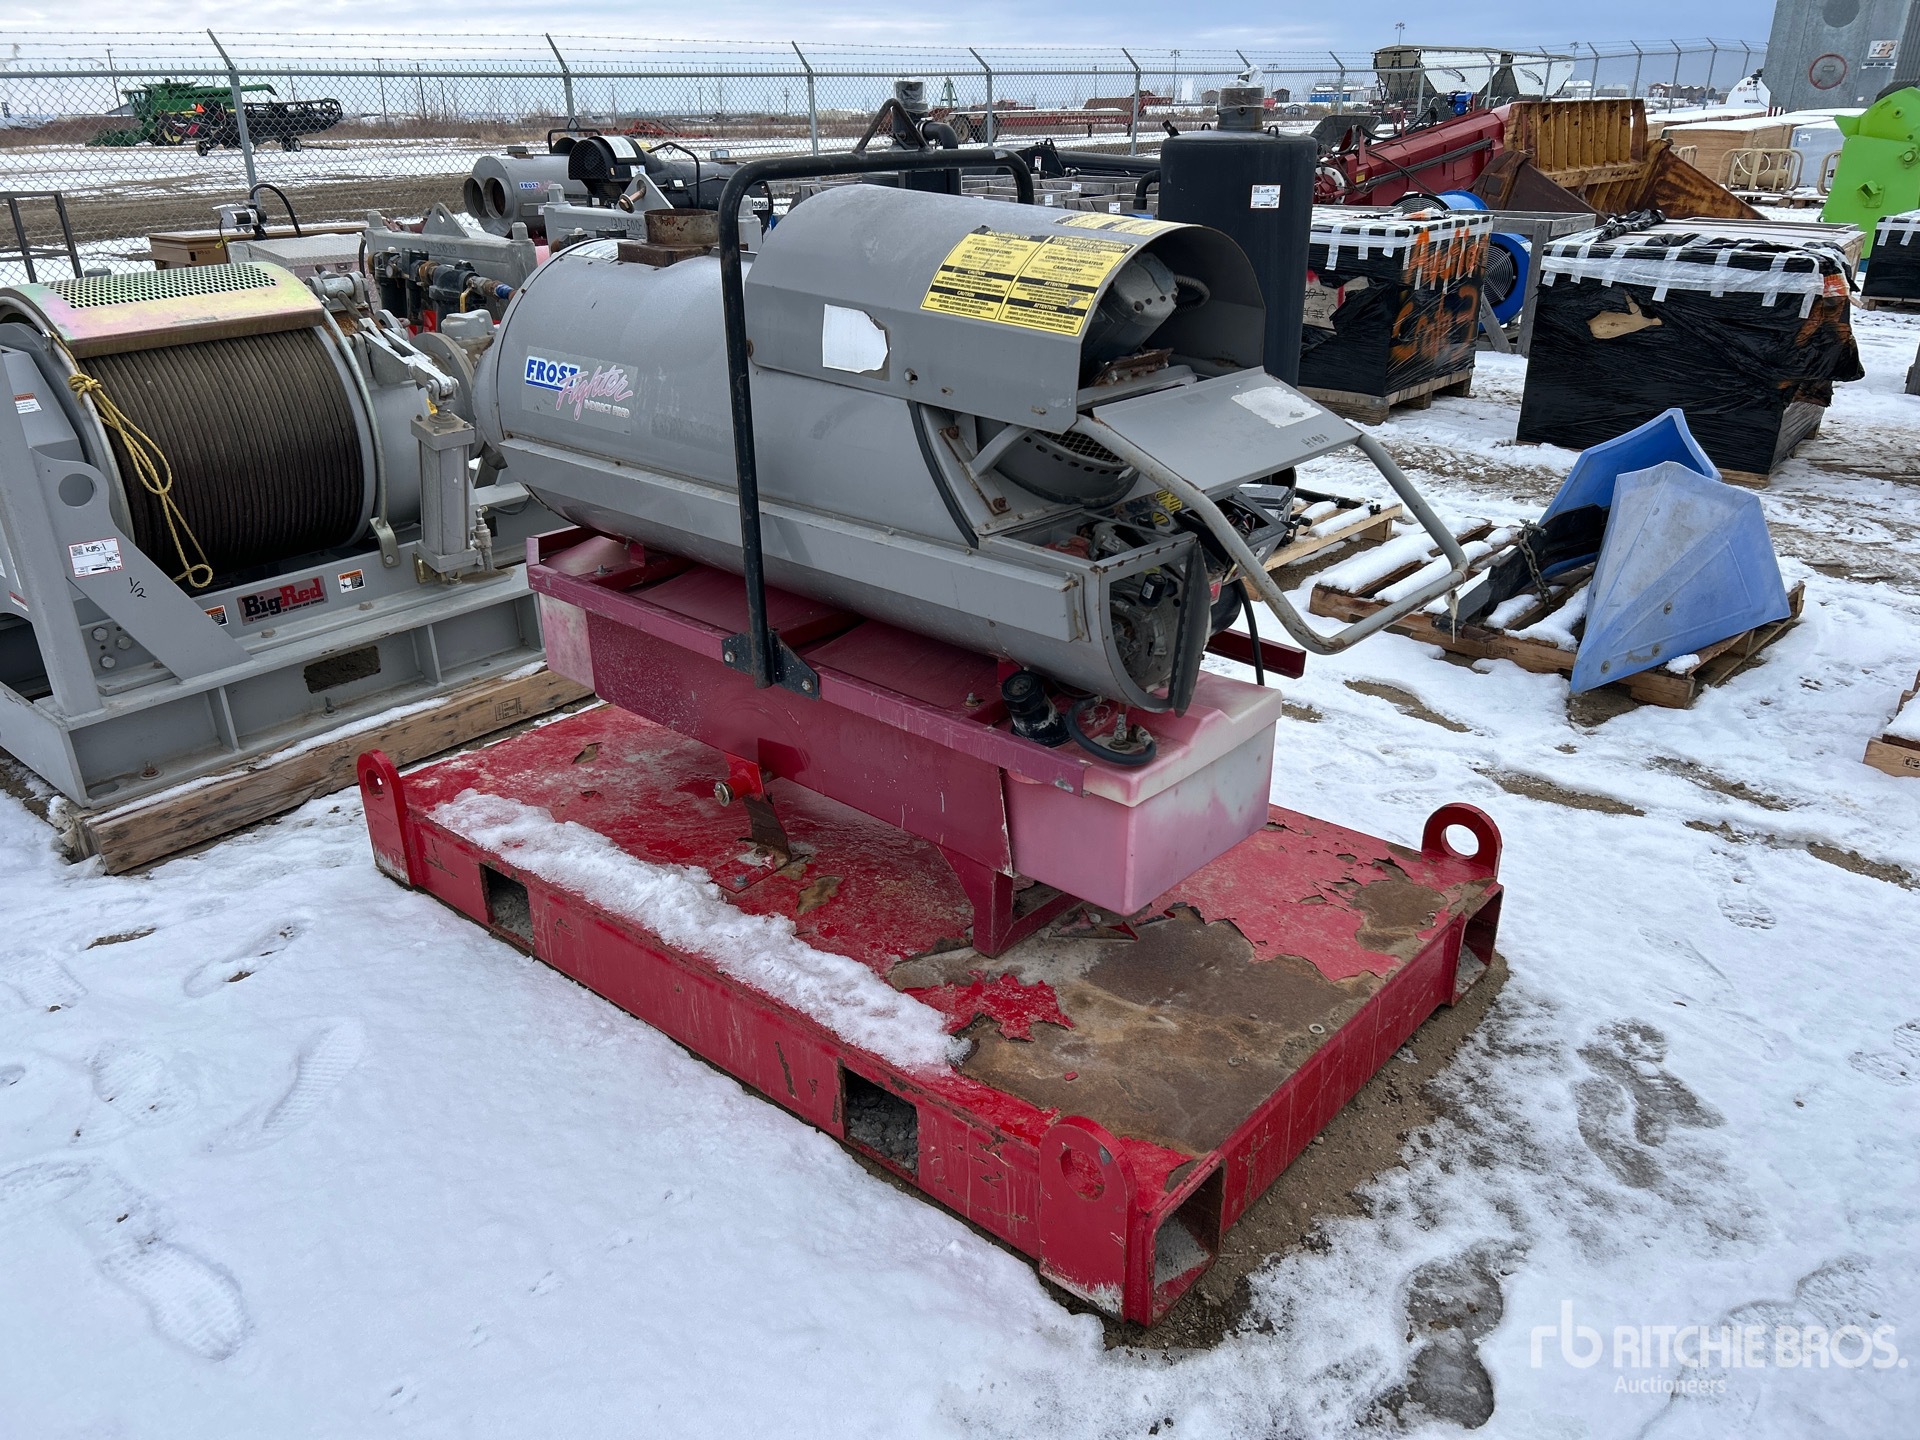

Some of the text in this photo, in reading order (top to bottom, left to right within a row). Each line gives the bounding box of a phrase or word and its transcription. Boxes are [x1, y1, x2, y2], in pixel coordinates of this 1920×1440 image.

[525, 357, 578, 388] FROST
[556, 365, 633, 420] Fighter
[129, 576, 147, 599] 1/2
